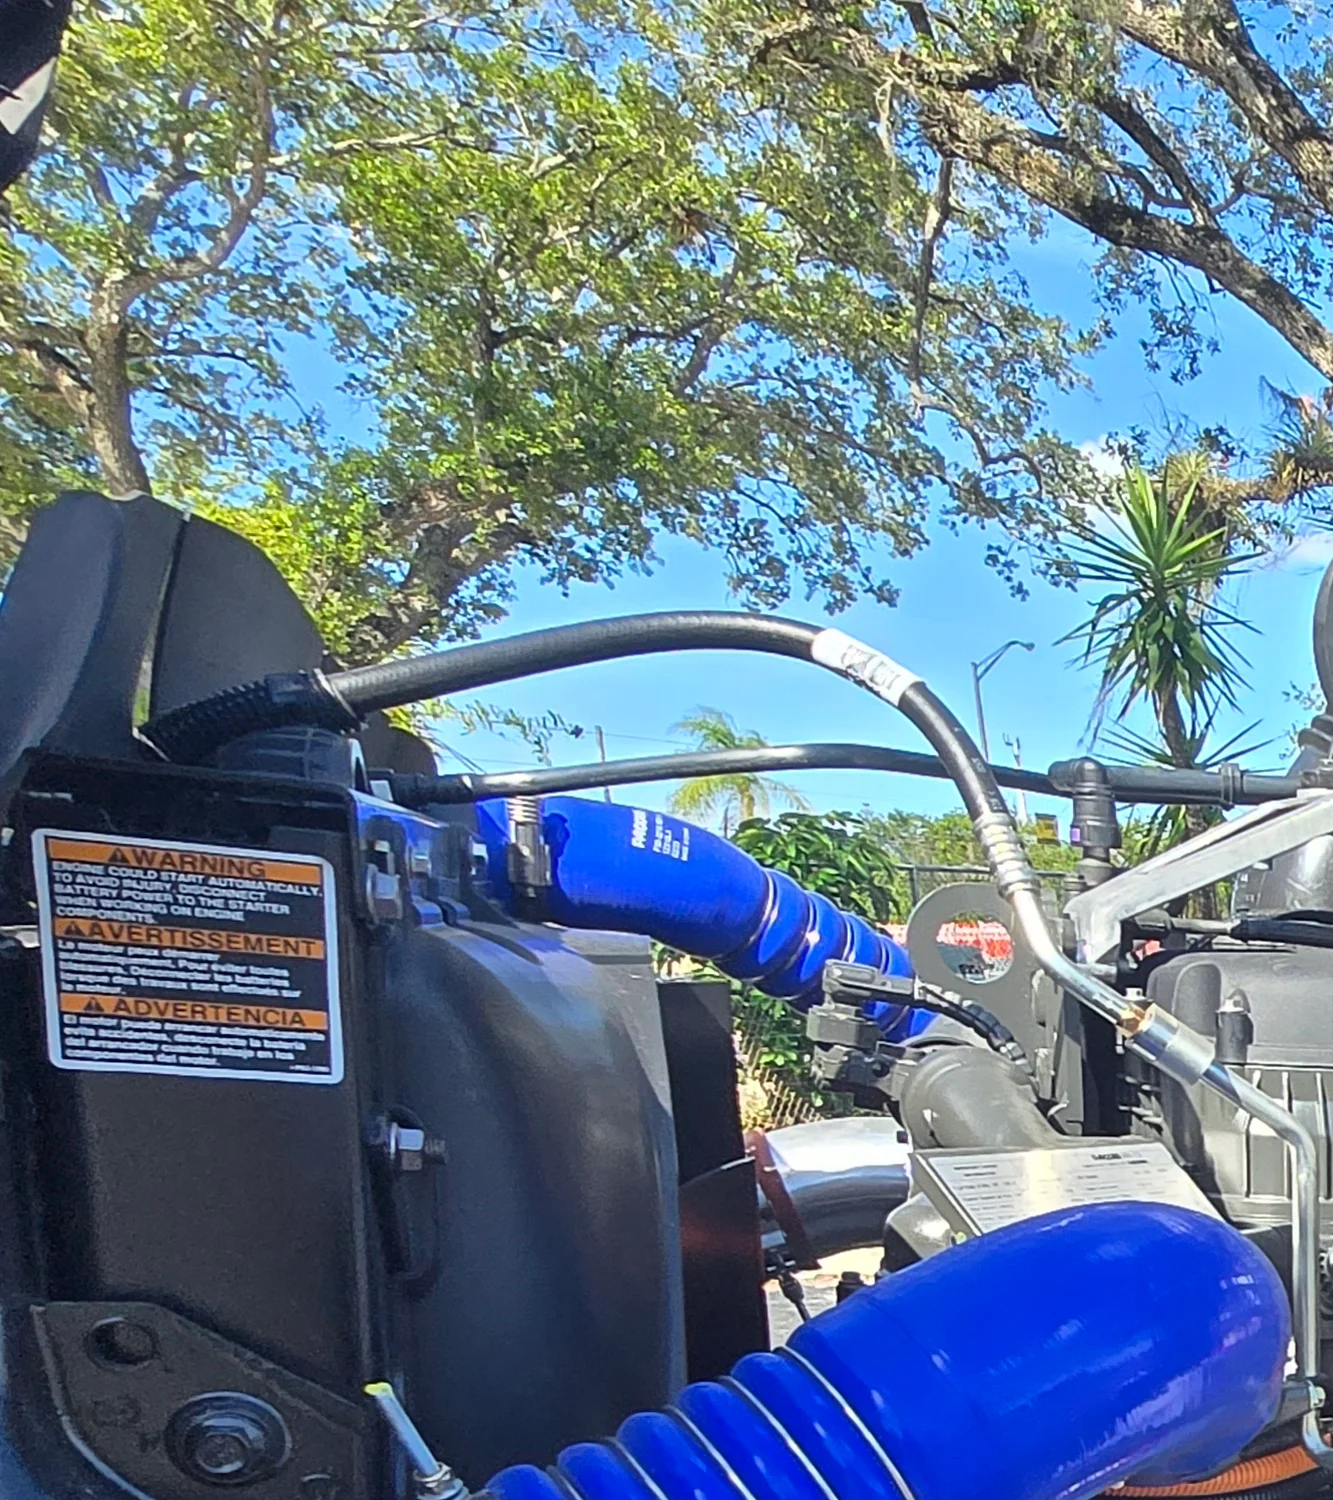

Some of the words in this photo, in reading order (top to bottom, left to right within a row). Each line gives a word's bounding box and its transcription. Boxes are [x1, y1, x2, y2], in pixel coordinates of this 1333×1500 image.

[132, 848, 265, 878] WARNING
[53, 861, 105, 875] ENGINE
[108, 866, 158, 880] COULD
[160, 871, 205, 885] START
[208, 877, 323, 897] AUTOMATICALLY.
[53, 872, 73, 883] TO
[75, 874, 120, 888] AVOID
[178, 883, 267, 901] DISCONNECT
[54, 884, 118, 898] BATTERY
[122, 889, 174, 903] POWER
[176, 894, 196, 905] TO
[198, 896, 225, 908] THE
[228, 900, 291, 915] STARTER
[54, 895, 98, 907] WHEN
[100, 899, 168, 914] WORKING
[170, 905, 192, 917] ON
[194, 908, 245, 921] ENGINE
[56, 906, 158, 924] COMPONENTS.
[88, 922, 316, 956] AVERTISSEMENT
[112, 998, 306, 1027] ADVERTENCIA
